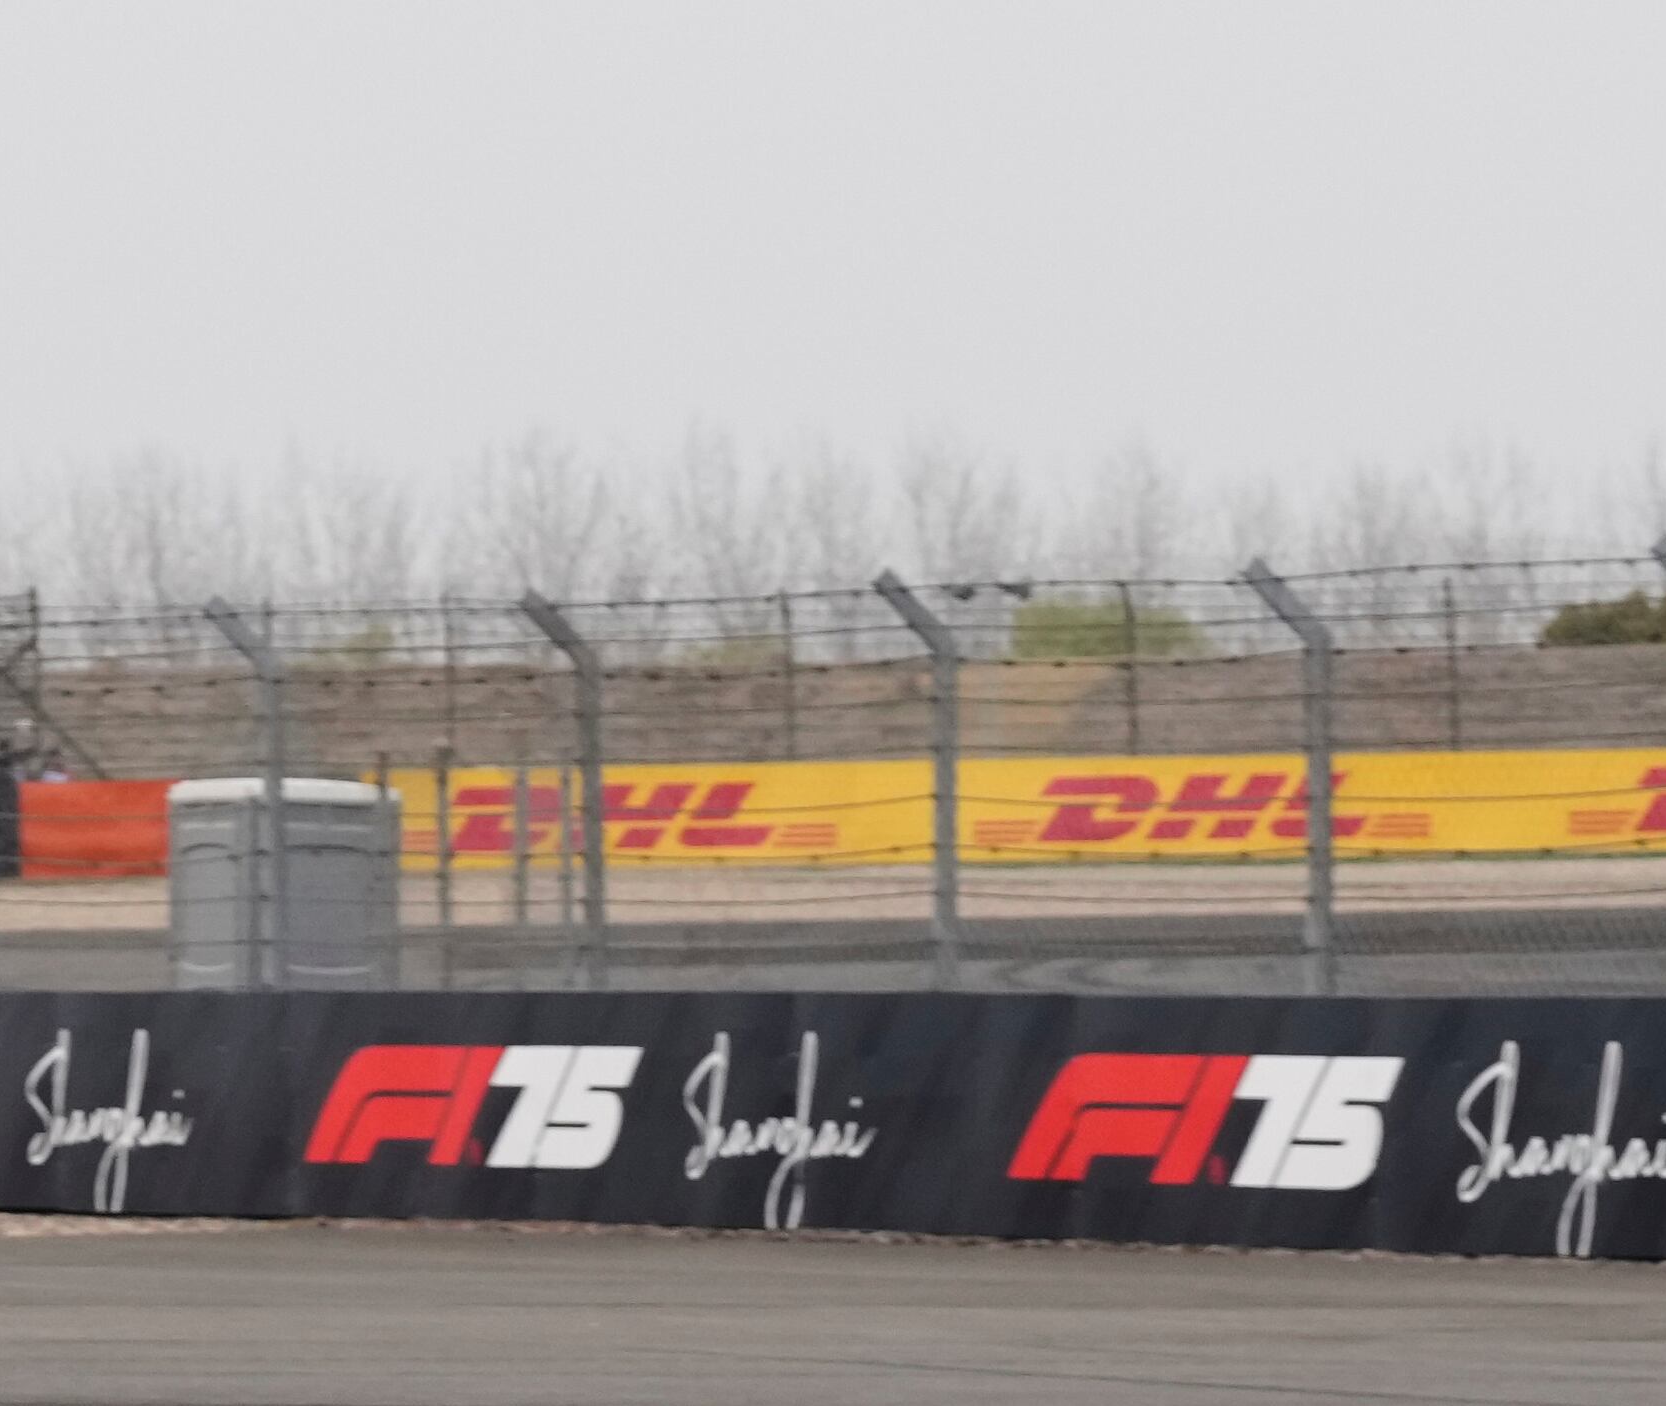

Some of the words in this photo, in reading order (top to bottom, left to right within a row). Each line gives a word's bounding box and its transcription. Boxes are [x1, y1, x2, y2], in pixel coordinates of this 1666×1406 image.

[449, 782, 773, 852] DHL
[1039, 772, 1368, 841] DHL
[25, 1028, 194, 1212] Shanghai
[683, 1031, 876, 1230] Shanghai
